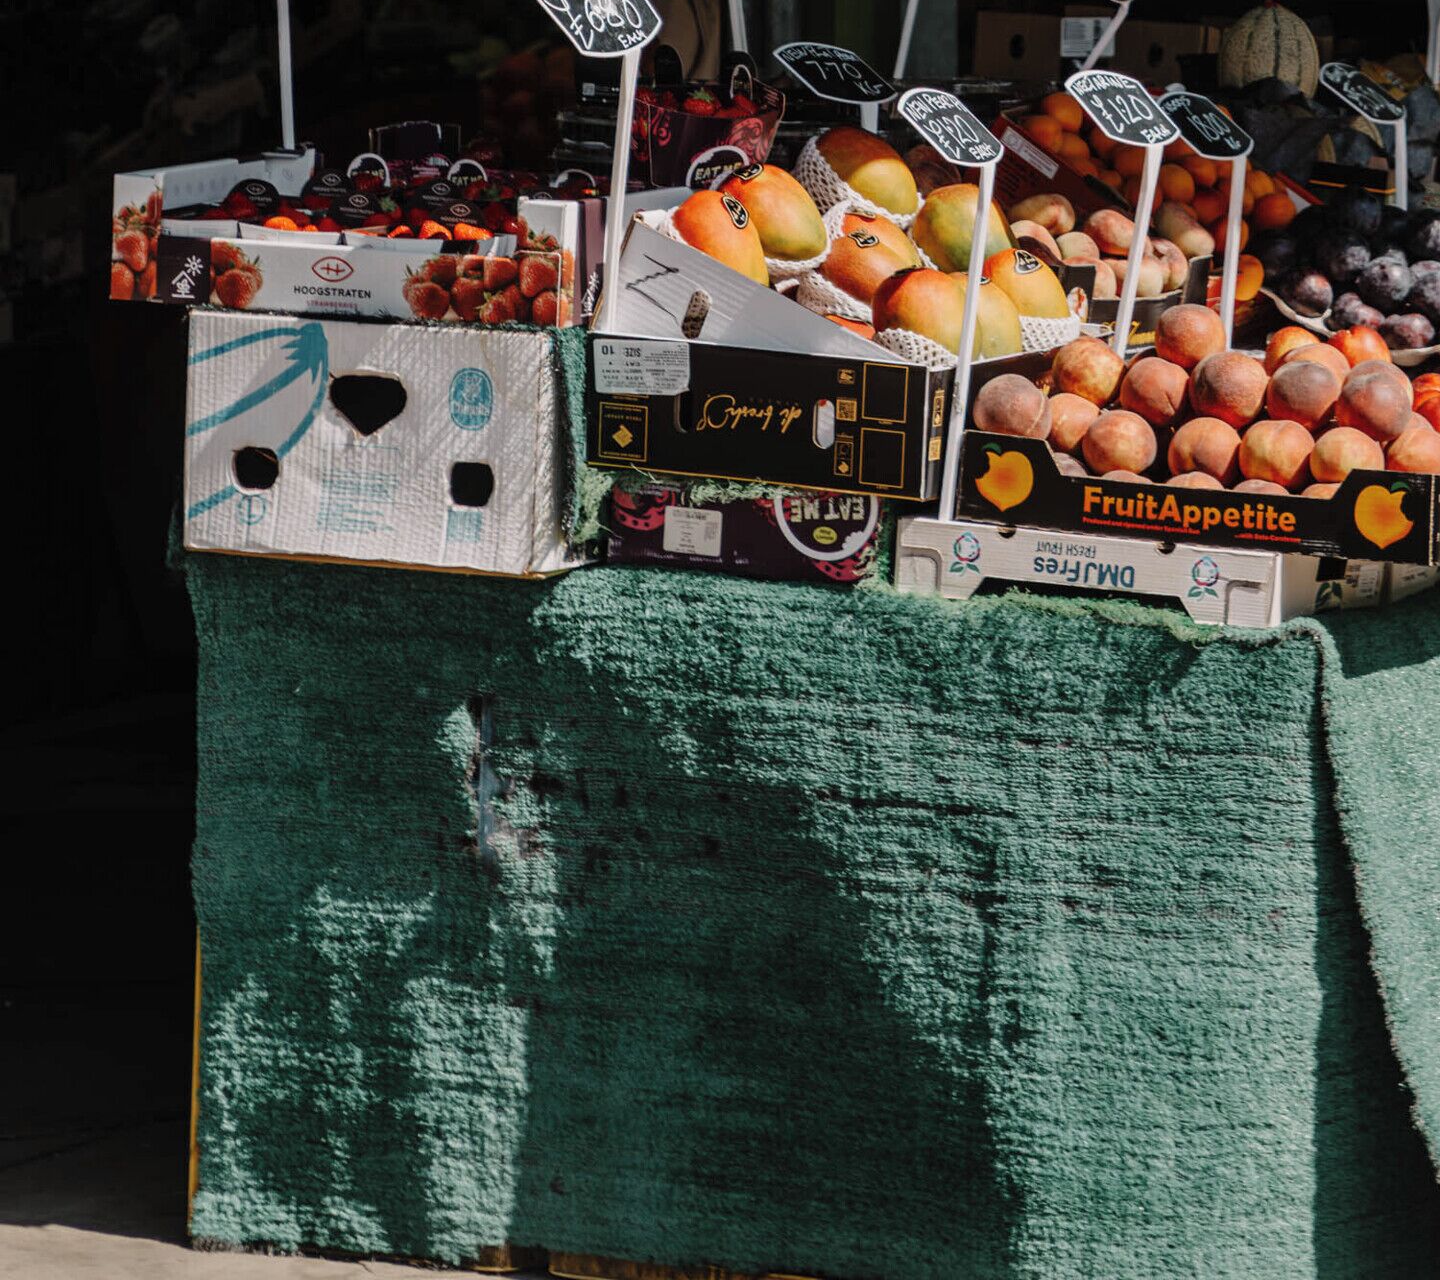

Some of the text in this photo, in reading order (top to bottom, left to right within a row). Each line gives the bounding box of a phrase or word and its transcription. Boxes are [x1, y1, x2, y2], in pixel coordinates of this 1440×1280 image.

[905, 95, 933, 122] NEW
[694, 165, 722, 181] EAT
[293, 285, 372, 299] HOOGSTRATEN
[601, 345, 615, 355] 10
[789, 495, 865, 523] EAT ME
[1083, 485, 1297, 532] FruitAppetite
